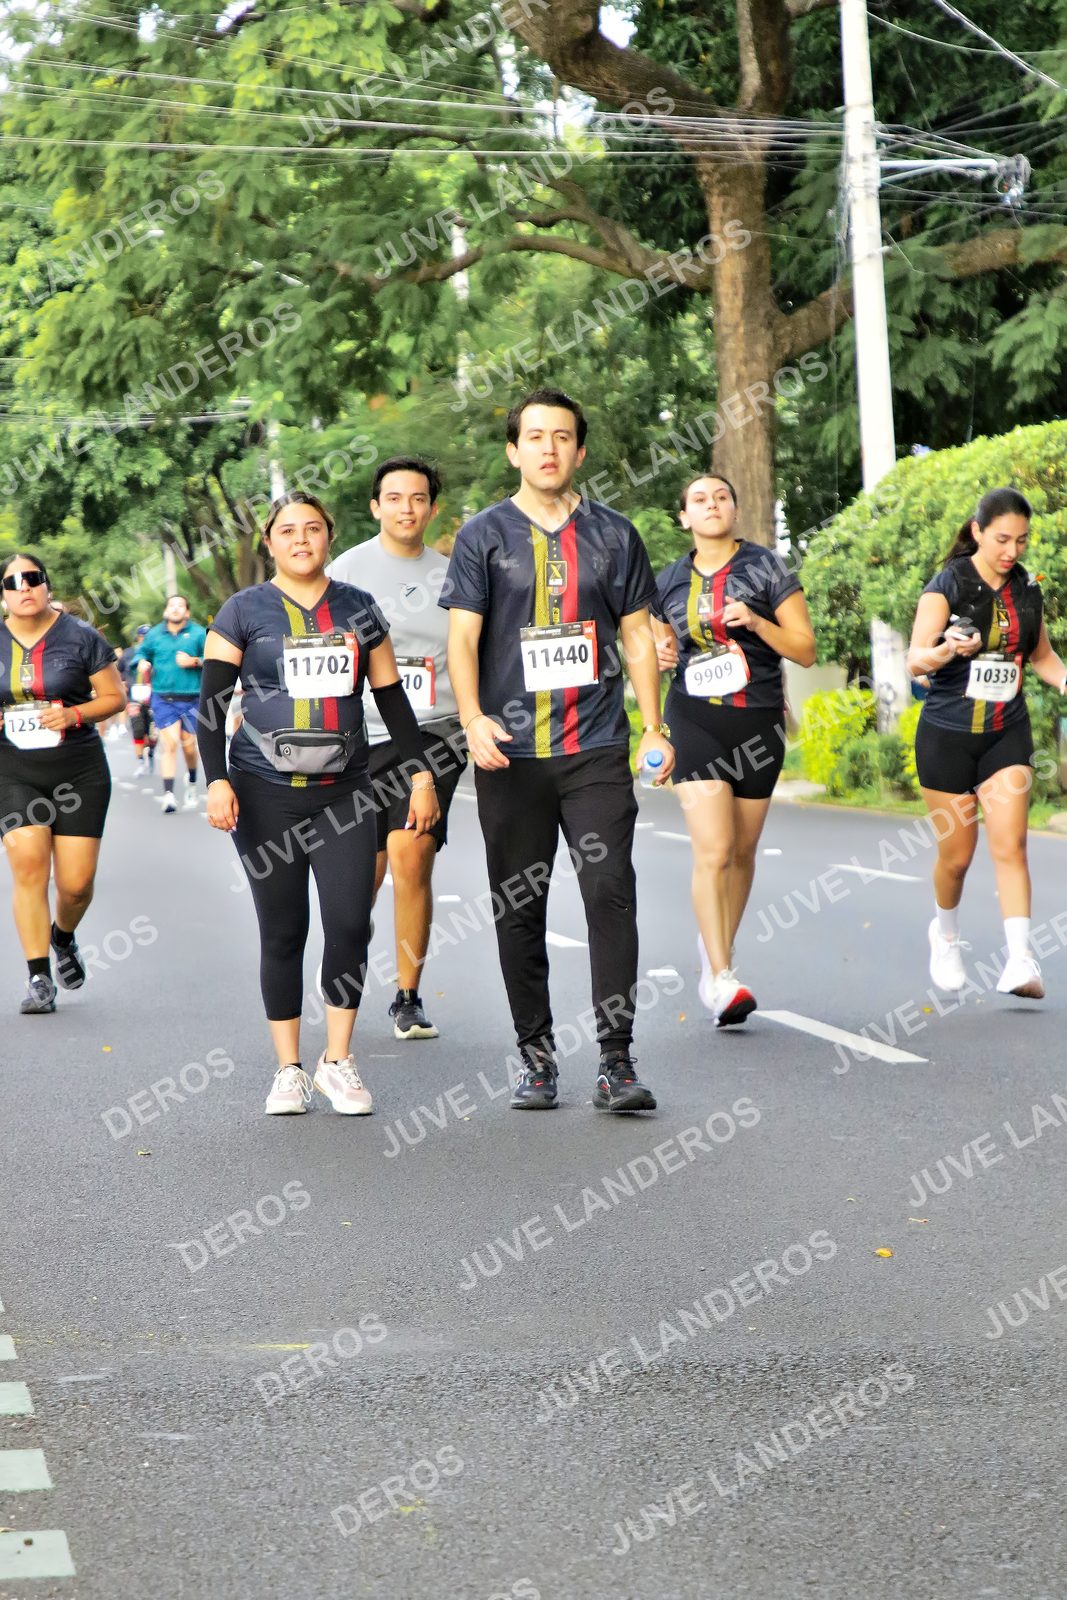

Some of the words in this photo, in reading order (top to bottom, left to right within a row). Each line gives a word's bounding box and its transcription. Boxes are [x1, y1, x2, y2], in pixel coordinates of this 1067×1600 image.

[289, 655, 350, 677] 11702
[528, 643, 589, 669] 11440
[403, 673, 423, 690] 10
[693, 661, 733, 686] 9909
[974, 667, 1017, 684] 10339
